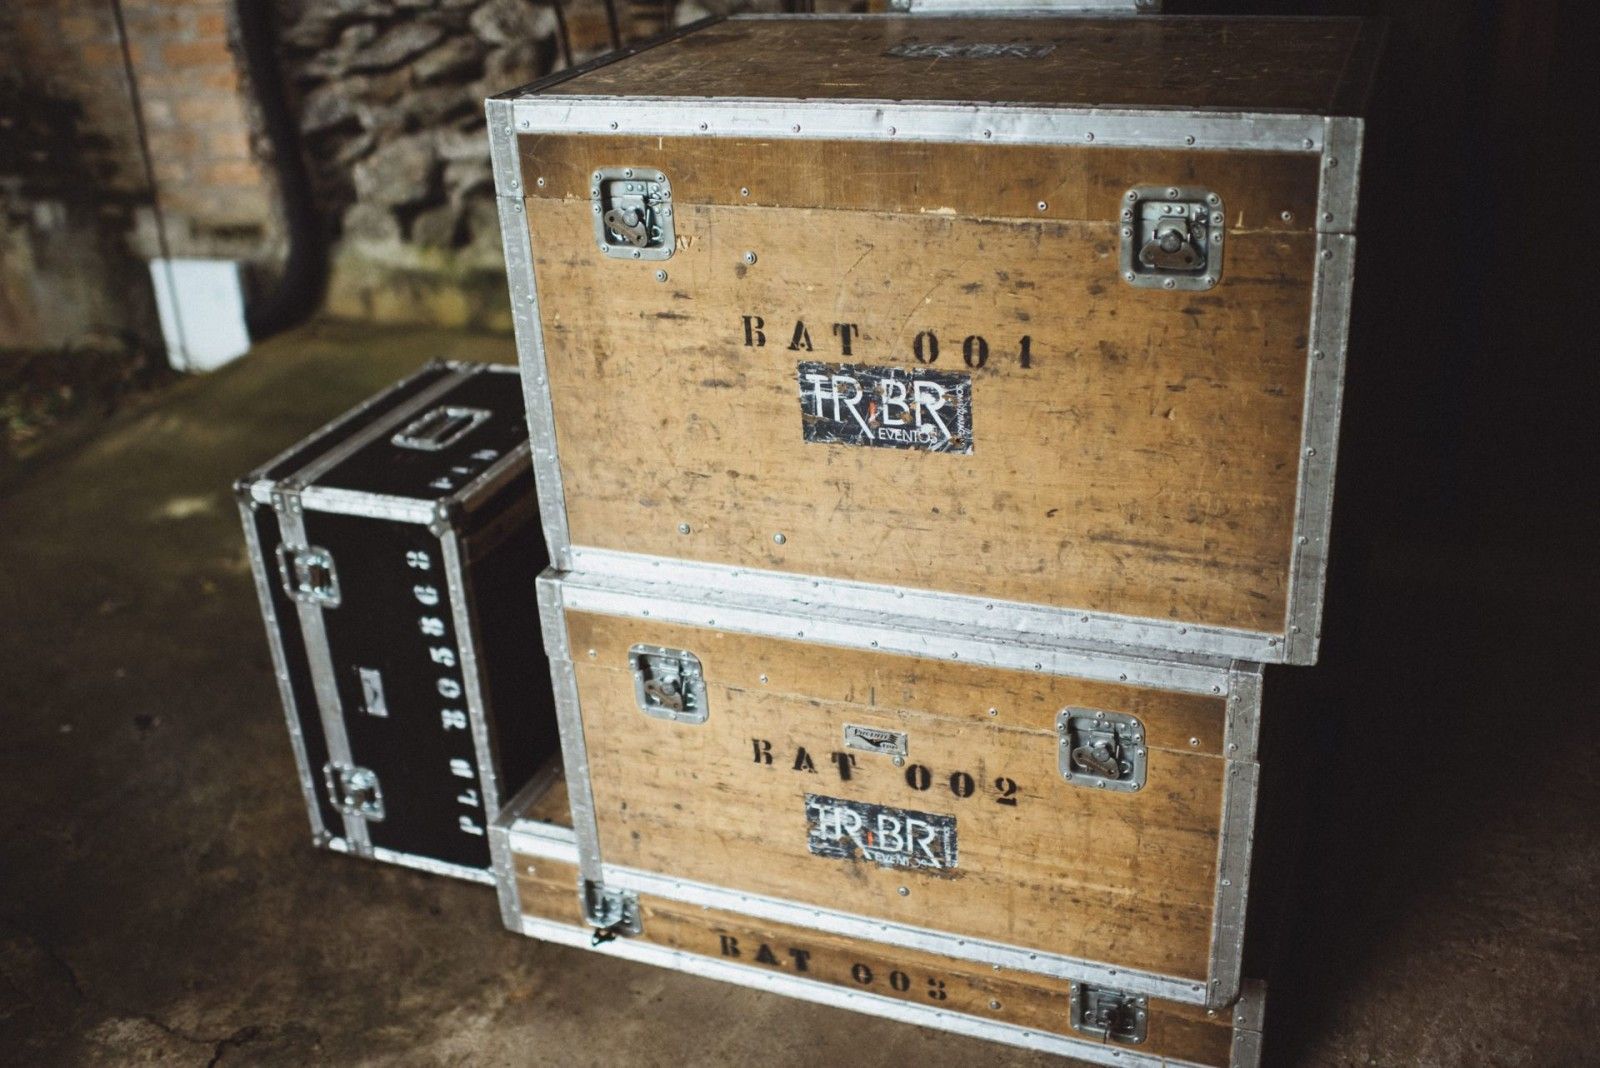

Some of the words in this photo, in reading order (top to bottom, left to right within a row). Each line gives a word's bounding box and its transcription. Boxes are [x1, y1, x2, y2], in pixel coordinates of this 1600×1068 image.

[742, 315, 859, 356] BAT
[913, 330, 1031, 370] 001
[878, 427, 939, 444] EVENTOS
[905, 763, 1018, 806] 002
